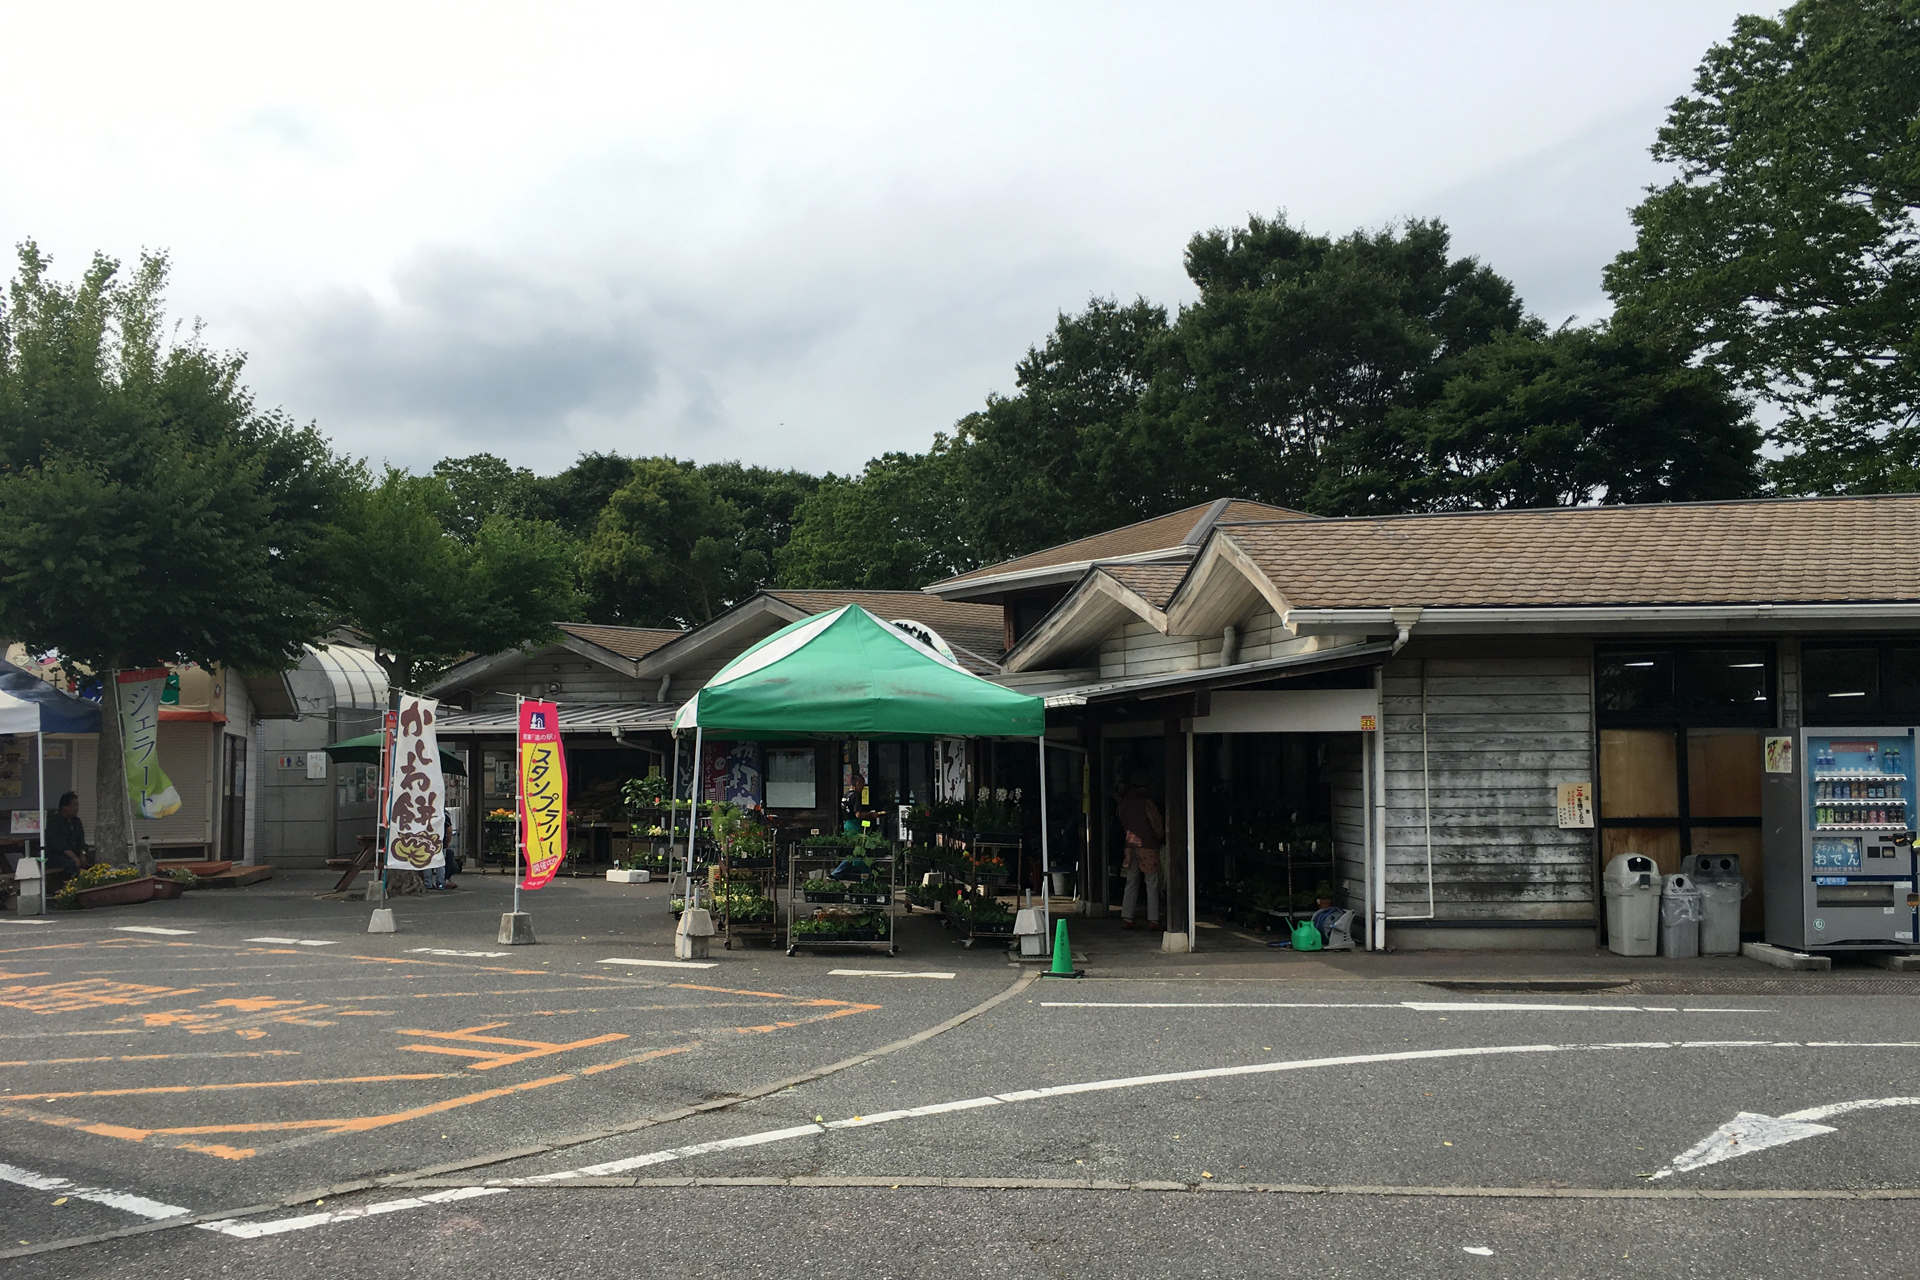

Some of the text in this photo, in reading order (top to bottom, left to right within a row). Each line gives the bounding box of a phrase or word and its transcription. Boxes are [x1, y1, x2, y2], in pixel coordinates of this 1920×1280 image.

[128, 685, 156, 808] ジェラート
[391, 701, 437, 832] かしわ餅
[530, 748, 560, 854] スタンプラリー
[1577, 785, 1585, 825] ごみを捨てるな
[1815, 853, 1860, 865] おでん
